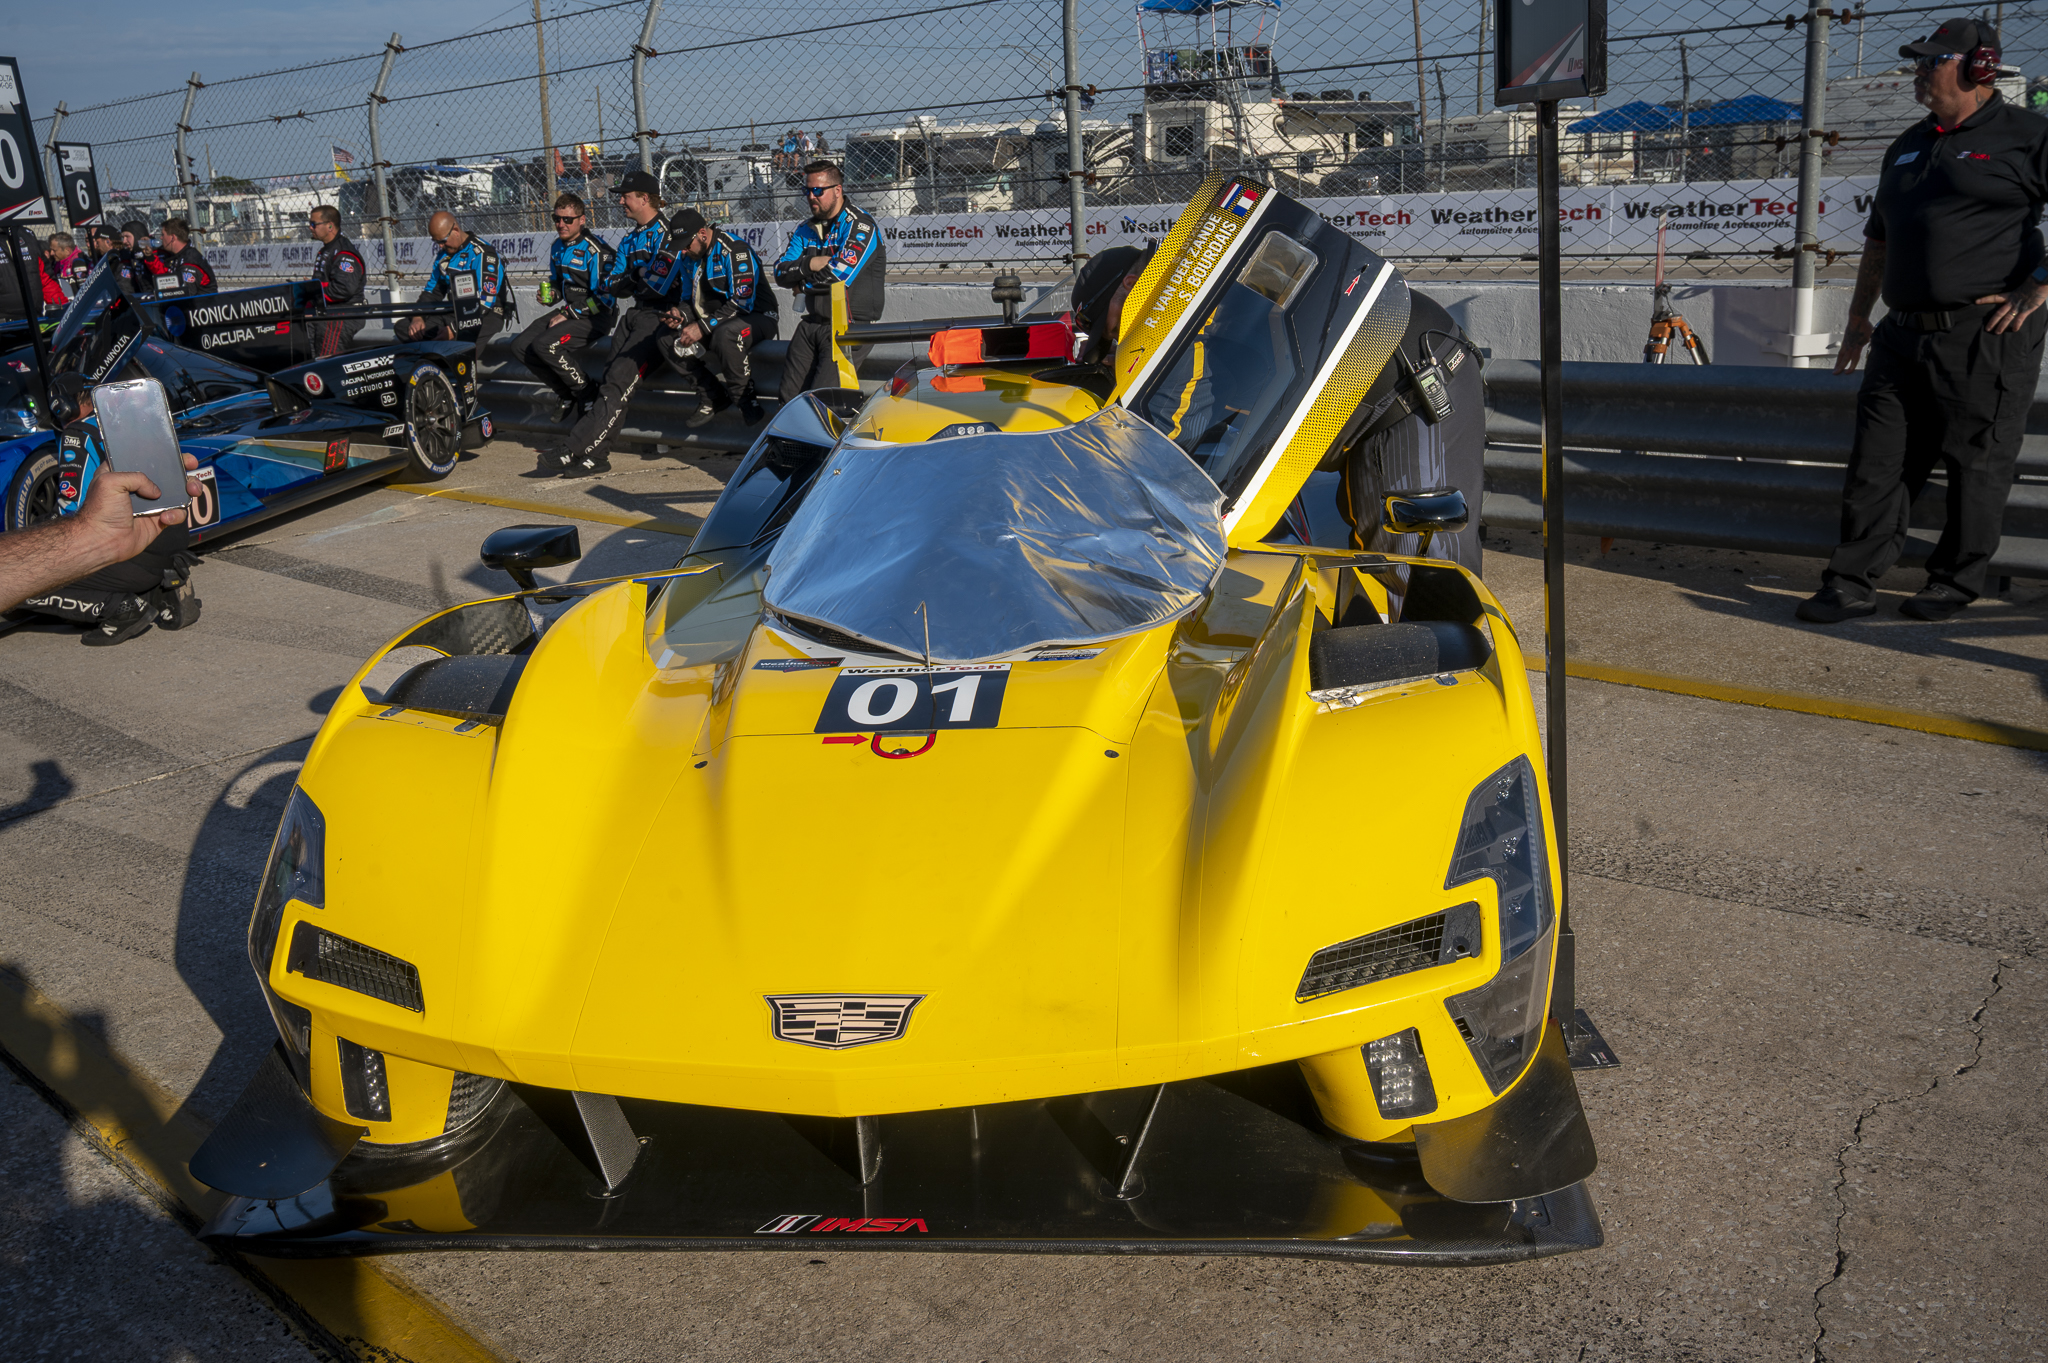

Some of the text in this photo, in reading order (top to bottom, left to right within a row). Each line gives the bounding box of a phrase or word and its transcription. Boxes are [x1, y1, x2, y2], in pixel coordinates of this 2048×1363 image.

[76, 178, 90, 211] 6
[1460, 225, 1513, 235] Automotive
[1722, 218, 1791, 229] Accessories
[884, 225, 984, 240] WeatherTech
[400, 241, 414, 258] JAY
[517, 237, 534, 256] JAY
[902, 240, 968, 249] Automotive Accessories
[1015, 239, 1051, 248] Automotive
[241, 247, 269, 262] ALAN JAY
[282, 247, 313, 261] ALAN JAY
[1187, 220, 1237, 288] BOURDAIS
[1144, 213, 1222, 328] R. VAN DER ZANDE
[189, 296, 290, 327] KONICA MINOLTA
[463, 318, 482, 328] ACURA
[212, 321, 290, 347] ACURA Type S
[103, 335, 130, 366] MINOLTA
[344, 361, 371, 372] HPD
[558, 355, 585, 384] ACURA
[345, 369, 395, 385] ACURA MOTORSPORTS
[347, 380, 393, 396] ELS STUDIO 3D
[64, 437, 81, 445] OMP
[34, 462, 46, 473] PILOT
[848, 664, 1003, 674] WeatherTech
[847, 674, 982, 725] 01
[810, 1217, 929, 1233] IMSA
